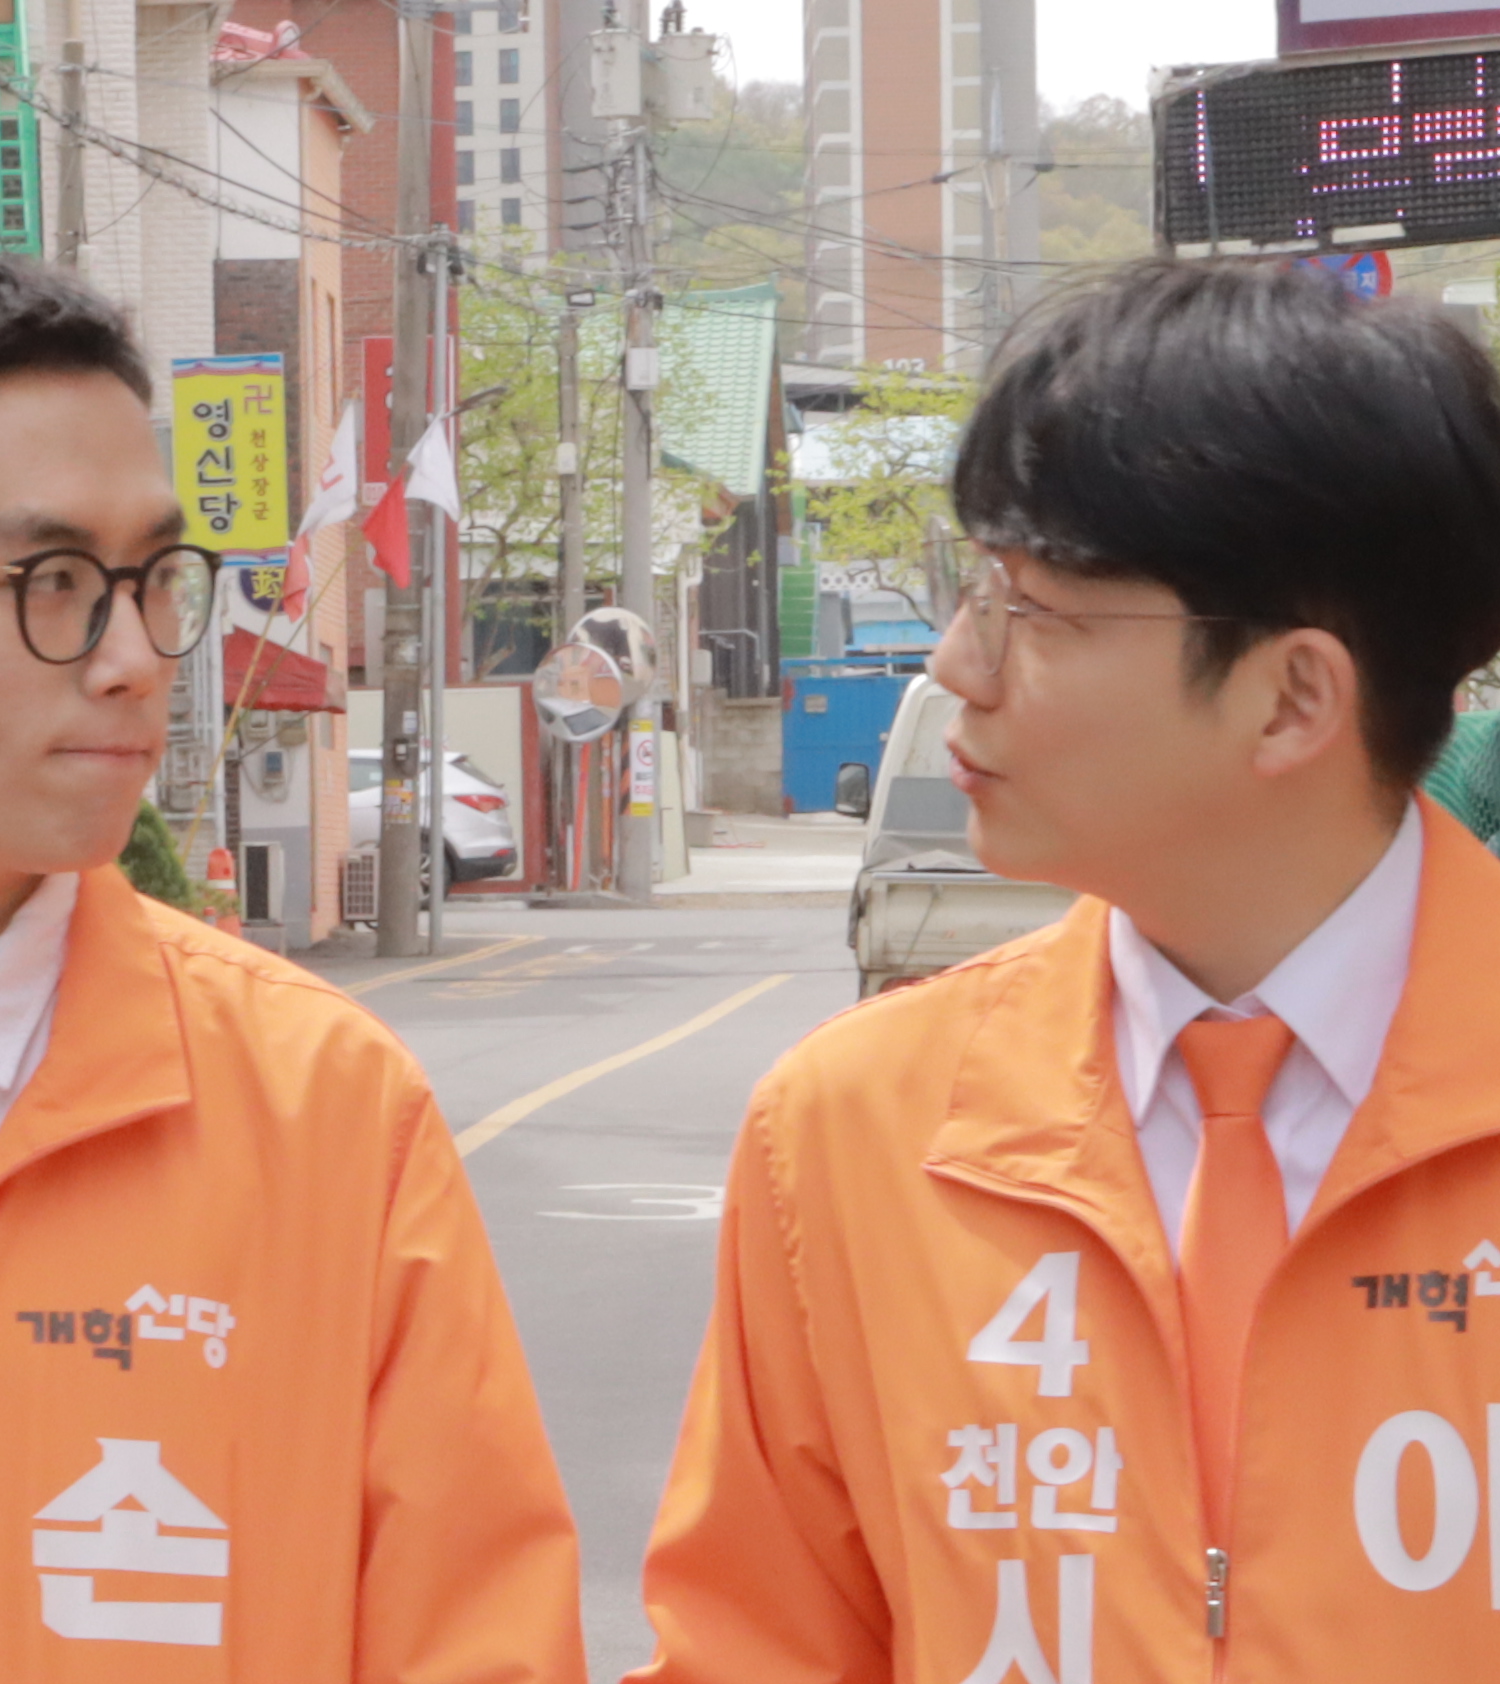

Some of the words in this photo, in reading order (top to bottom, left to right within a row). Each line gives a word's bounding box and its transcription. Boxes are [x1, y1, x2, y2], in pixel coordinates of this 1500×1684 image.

[193, 398, 242, 535] 영신당
[250, 428, 270, 521] 천상장군
[16, 1284, 236, 1370] 개혁신당
[965, 1251, 1090, 1397] 4
[940, 1423, 1123, 1533] 천안
